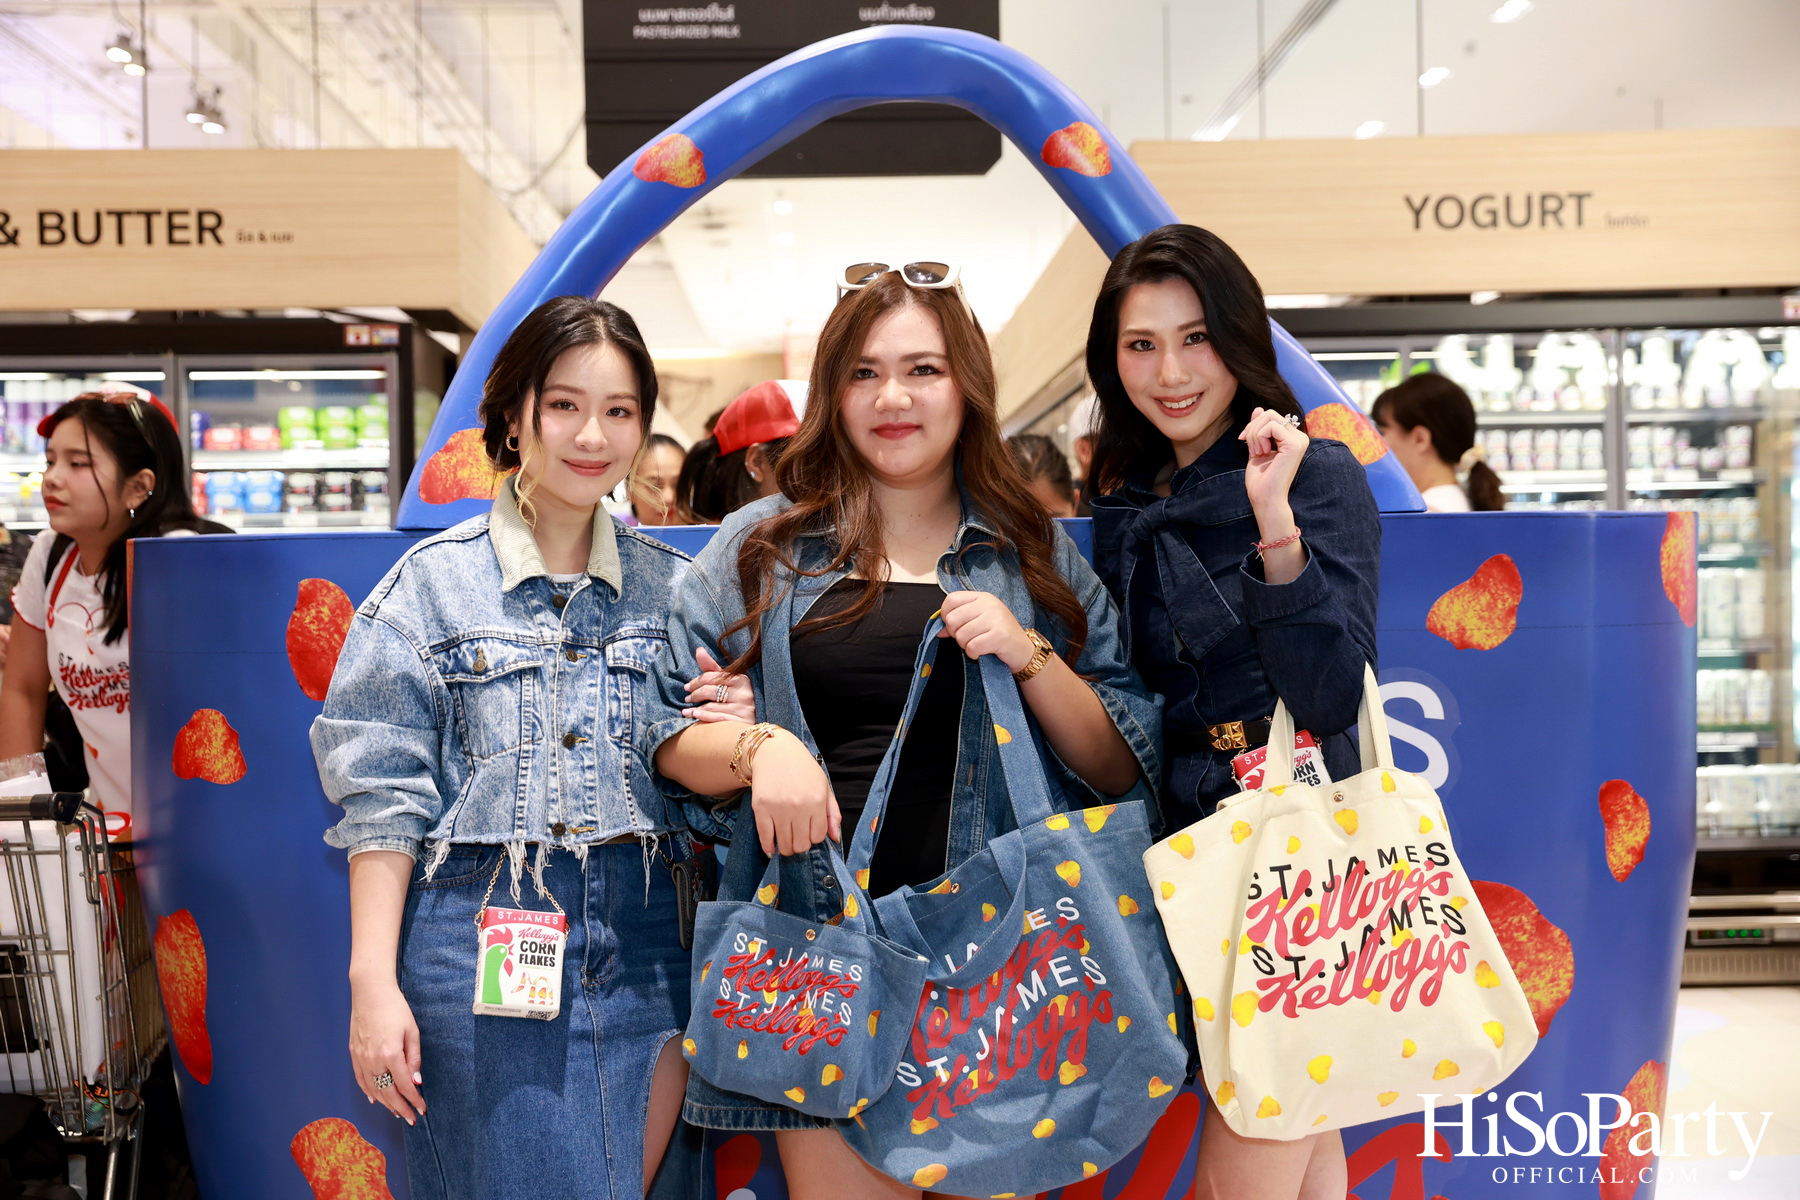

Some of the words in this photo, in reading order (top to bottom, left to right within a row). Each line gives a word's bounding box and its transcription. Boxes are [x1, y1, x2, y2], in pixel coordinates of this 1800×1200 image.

[711, 25, 741, 39] MILK
[37, 209, 224, 246] BUTTER
[1405, 191, 1593, 230] YOGURT
[497, 911, 559, 925] ST.JAMES
[1246, 860, 1454, 958] Kellogg's
[518, 927, 560, 943] Kellogg's
[520, 940, 556, 956] CORN
[734, 932, 863, 982] ST.JAMES
[1251, 896, 1467, 981] ST.JAMES
[519, 954, 556, 968] FLAKES
[723, 948, 860, 1001] Kellogg's
[1256, 922, 1471, 1018] Kellogg's
[720, 977, 852, 1026] ST.JAMES
[896, 956, 1107, 1087] ST.JAMES
[712, 998, 848, 1056] Kellogg's
[906, 975, 1113, 1121] Kellogg's
